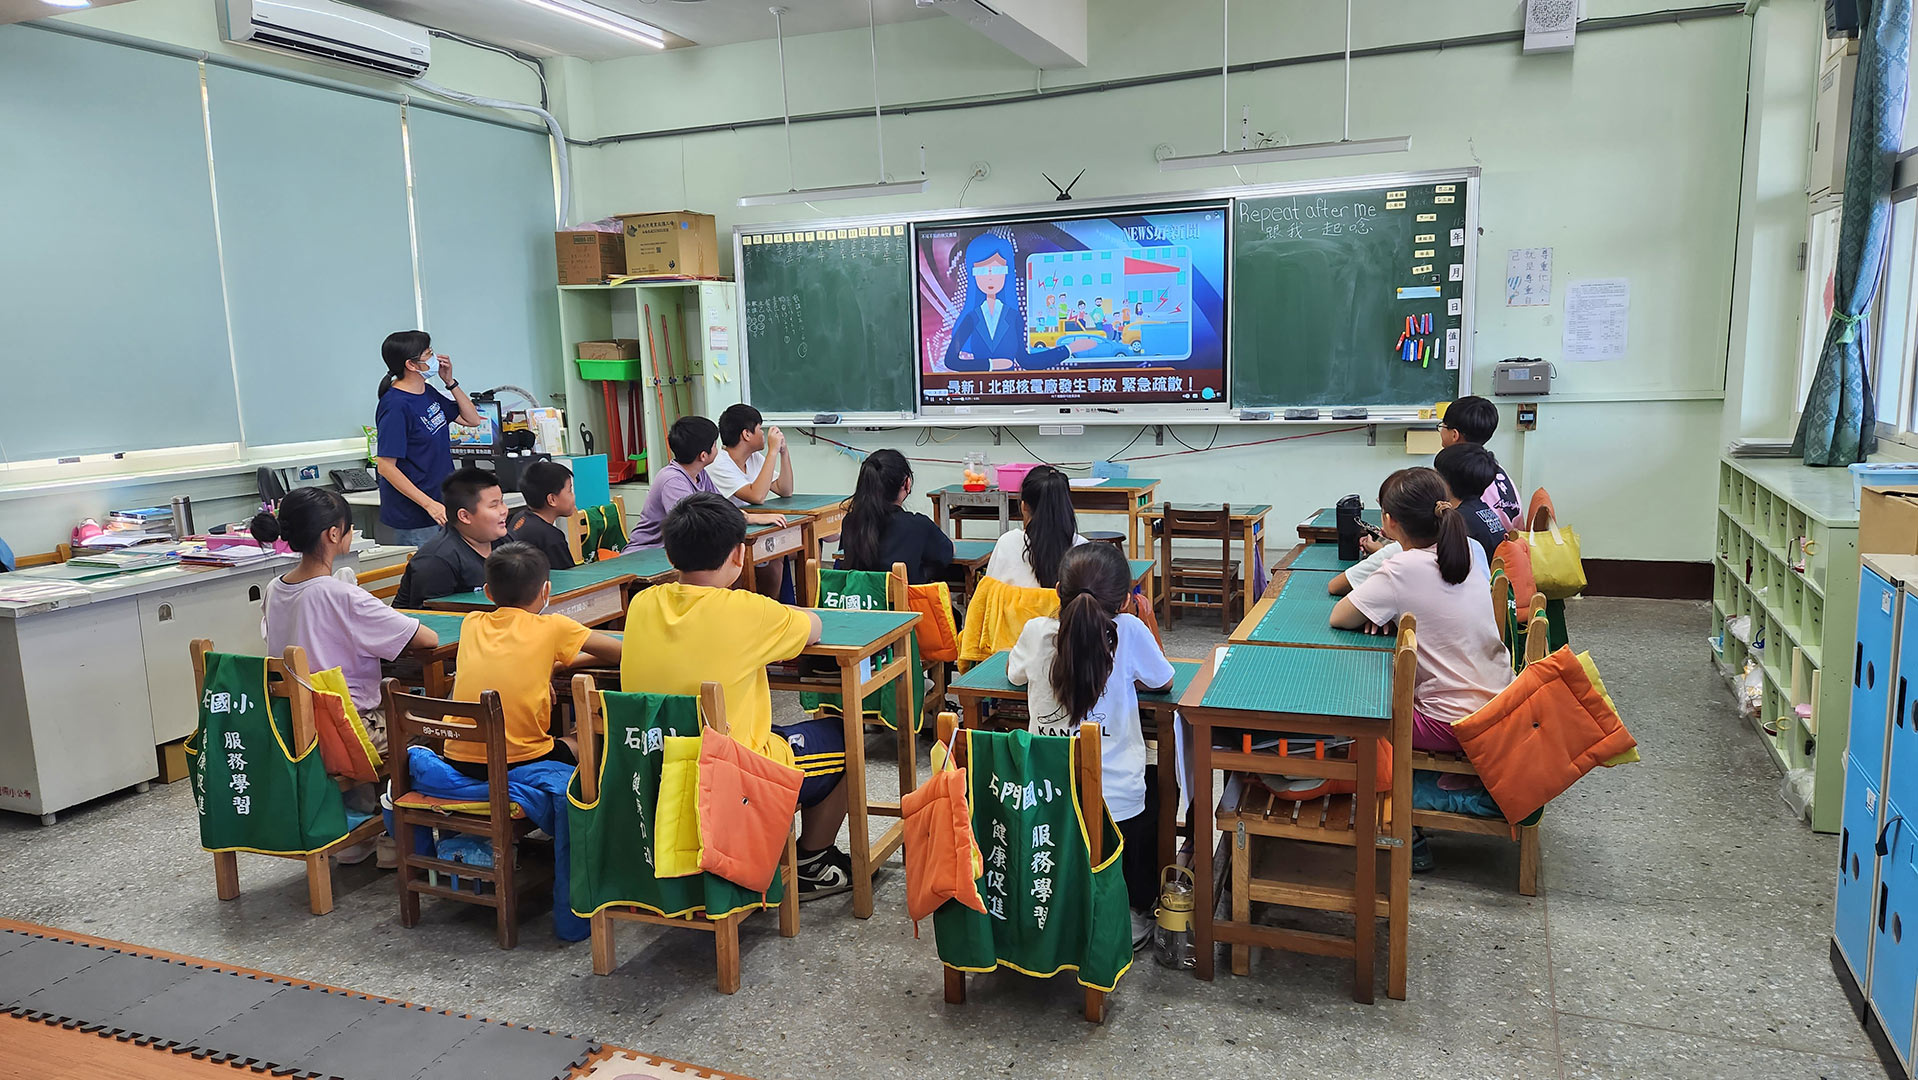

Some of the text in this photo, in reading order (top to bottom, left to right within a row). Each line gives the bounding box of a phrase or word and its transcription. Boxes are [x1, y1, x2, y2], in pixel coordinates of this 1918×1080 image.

[1240, 197, 1377, 230] Repeat after me
[1265, 218, 1374, 239] 跟我一起唸
[1452, 232, 1463, 243] 年
[1452, 267, 1460, 278] 月
[1451, 302, 1458, 311] 日
[1448, 332, 1457, 367] 值日生
[948, 375, 1193, 395] 最新！北部核電廠發生事故 緊急疏散！
[824, 592, 878, 610] 石國小
[1038, 726, 1111, 737] KANL
[224, 732, 251, 815] 服務學習
[986, 819, 1008, 921] 健康促進
[1030, 824, 1055, 931] 服務學習
